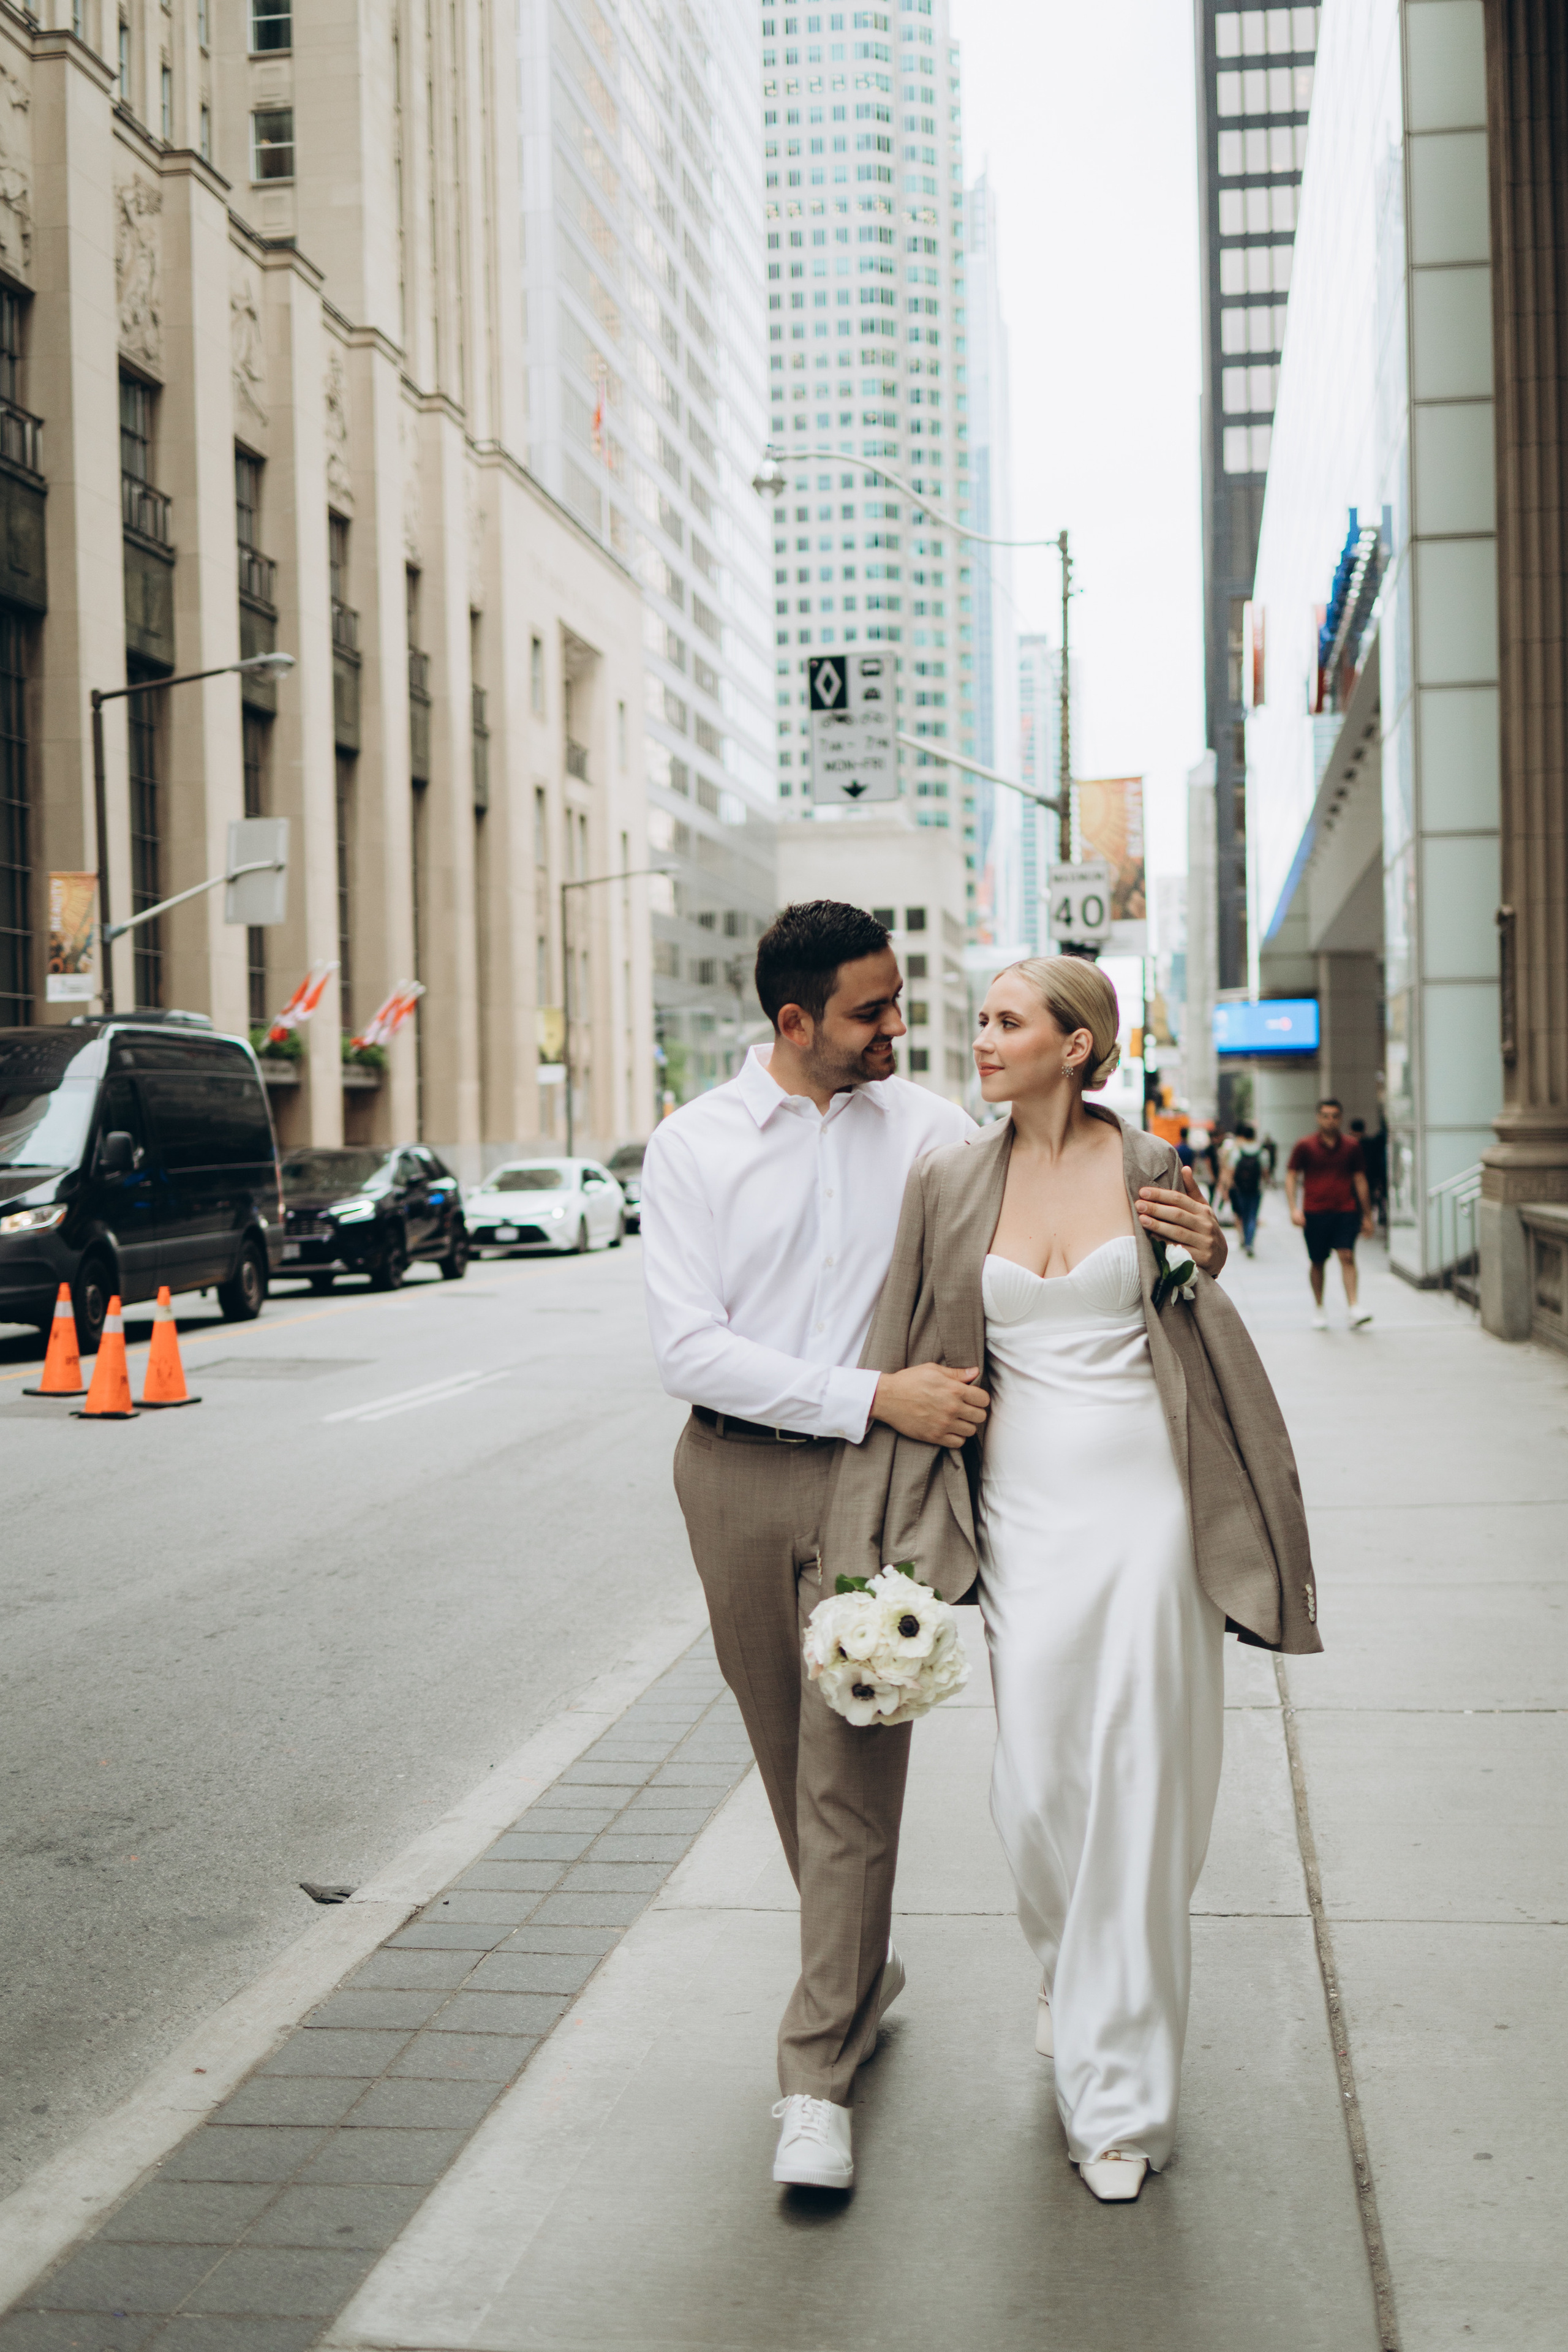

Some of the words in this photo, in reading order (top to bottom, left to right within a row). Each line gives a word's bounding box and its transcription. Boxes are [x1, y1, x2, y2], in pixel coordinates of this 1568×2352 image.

[1125, 780, 1144, 859] BEAUTY
[50, 877, 62, 932] BEAUTY
[1055, 895, 1104, 928] 40
